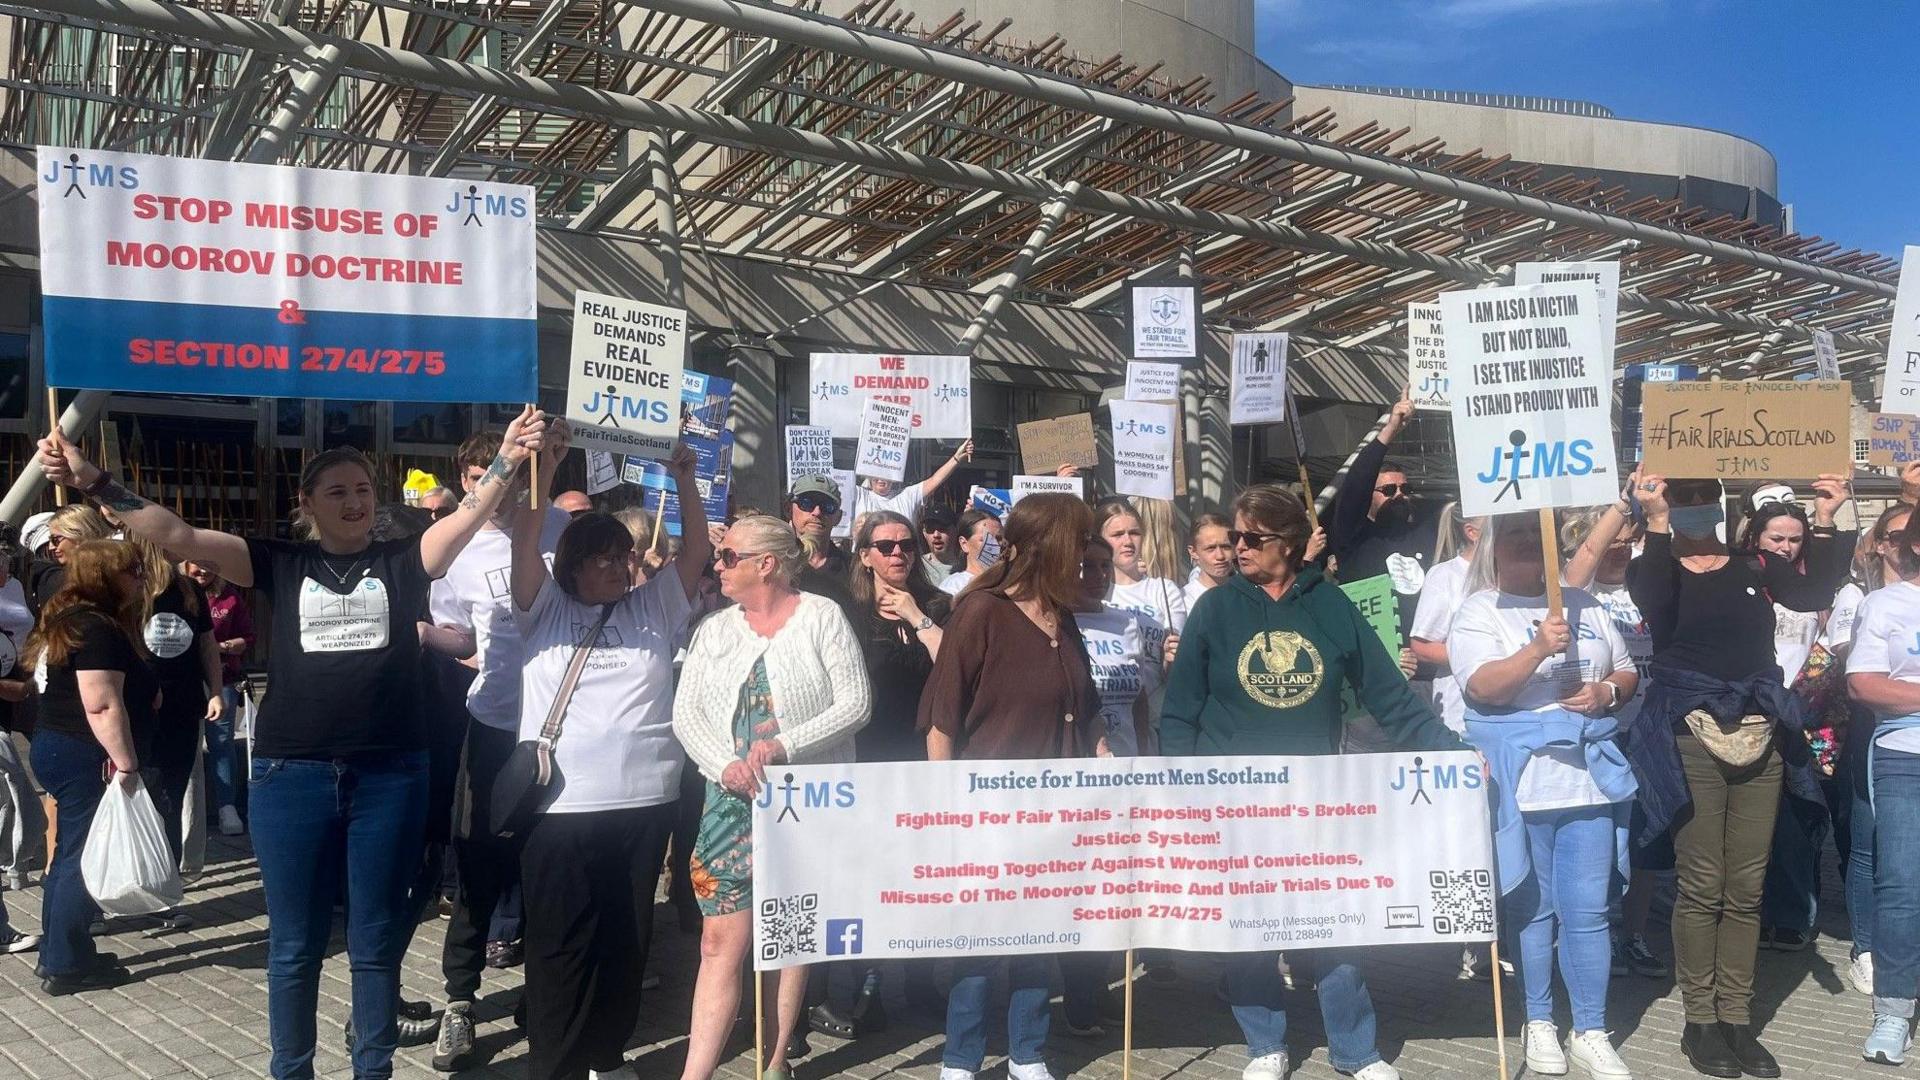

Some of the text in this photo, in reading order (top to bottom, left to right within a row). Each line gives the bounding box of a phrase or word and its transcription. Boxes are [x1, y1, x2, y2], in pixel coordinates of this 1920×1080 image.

[133, 193, 439, 238] STOP MISUSE OF
[107, 241, 464, 286] MOOROV DOCTRINE
[277, 299, 306, 325] &
[1468, 294, 1579, 324] I AM ALSO A VICTIM
[582, 301, 681, 333] REAL JUSTICE
[593, 322, 666, 347] DEMANDS
[1152, 327, 1172, 335] STAND
[1413, 336, 1431, 346] THE
[1482, 326, 1571, 354] BUT NOT BLIND,
[128, 338, 446, 376] SECTION 274/275
[606, 343, 652, 366] REAL
[1416, 348, 1428, 357] OF
[1430, 349, 1437, 358] A
[879, 357, 905, 370] WE
[583, 360, 670, 390] EVIDENCE
[1139, 369, 1175, 378] JUSTICE FOR
[1474, 356, 1586, 386] I SEE THE INJUSTICE
[854, 375, 929, 390] DEMAND
[1134, 378, 1163, 386] INNOCENT
[1665, 382, 1711, 392] JUSTICE
[1720, 383, 1739, 391] FOR
[1140, 387, 1171, 395] SCOTLAND
[583, 386, 669, 427] JIMS
[1466, 386, 1599, 417] I STAND PROUDLY WITH
[872, 403, 909, 417] INNOCENT
[880, 415, 900, 425] MEN:
[1873, 417, 1904, 432] SNP
[869, 421, 909, 434] THE BY-CATCH
[574, 427, 671, 451] #FairTrialsScotland
[790, 437, 831, 446] JUSTICE
[867, 436, 904, 448] JUSTICE NET
[883, 431, 906, 441] BROKEN
[1872, 439, 1907, 450] HUMAN
[1125, 452, 1154, 460] WOMENS
[791, 467, 831, 475] CAN SPEAK
[1114, 460, 1135, 468] MAKES
[1137, 462, 1155, 470] DADS
[1039, 482, 1073, 490] SURVIVOR
[308, 617, 381, 627] MOOROV DOCTRINE
[316, 633, 347, 641] ARTICLE
[1100, 679, 1140, 692] TRIALS
[1250, 674, 1313, 685] SCOTLAND
[969, 766, 1289, 793] Justice for Innocent Men Scotland
[895, 812, 974, 830] Fighting
[979, 811, 1010, 825] For
[1016, 809, 1053, 824] Fair
[1058, 807, 1112, 822] Trials
[1129, 806, 1212, 824] Exposing
[1216, 803, 1310, 820] Scotland's
[1315, 803, 1377, 817] Broken
[1072, 830, 1221, 849] Justice System!
[913, 852, 1363, 880] Standing Together Against Wrongful Convictions,
[880, 875, 1394, 904] Misuse Of The Moorov Doctrine And Unfair Trials Due To
[1073, 904, 1223, 922] Section 274/275
[1392, 912, 1415, 920] www.
[1229, 913, 1366, 930] WhatsApp (Messages Only)
[888, 931, 1081, 951] enquiries@jimsscotland.org
[1263, 928, 1333, 942] 07701 288499
